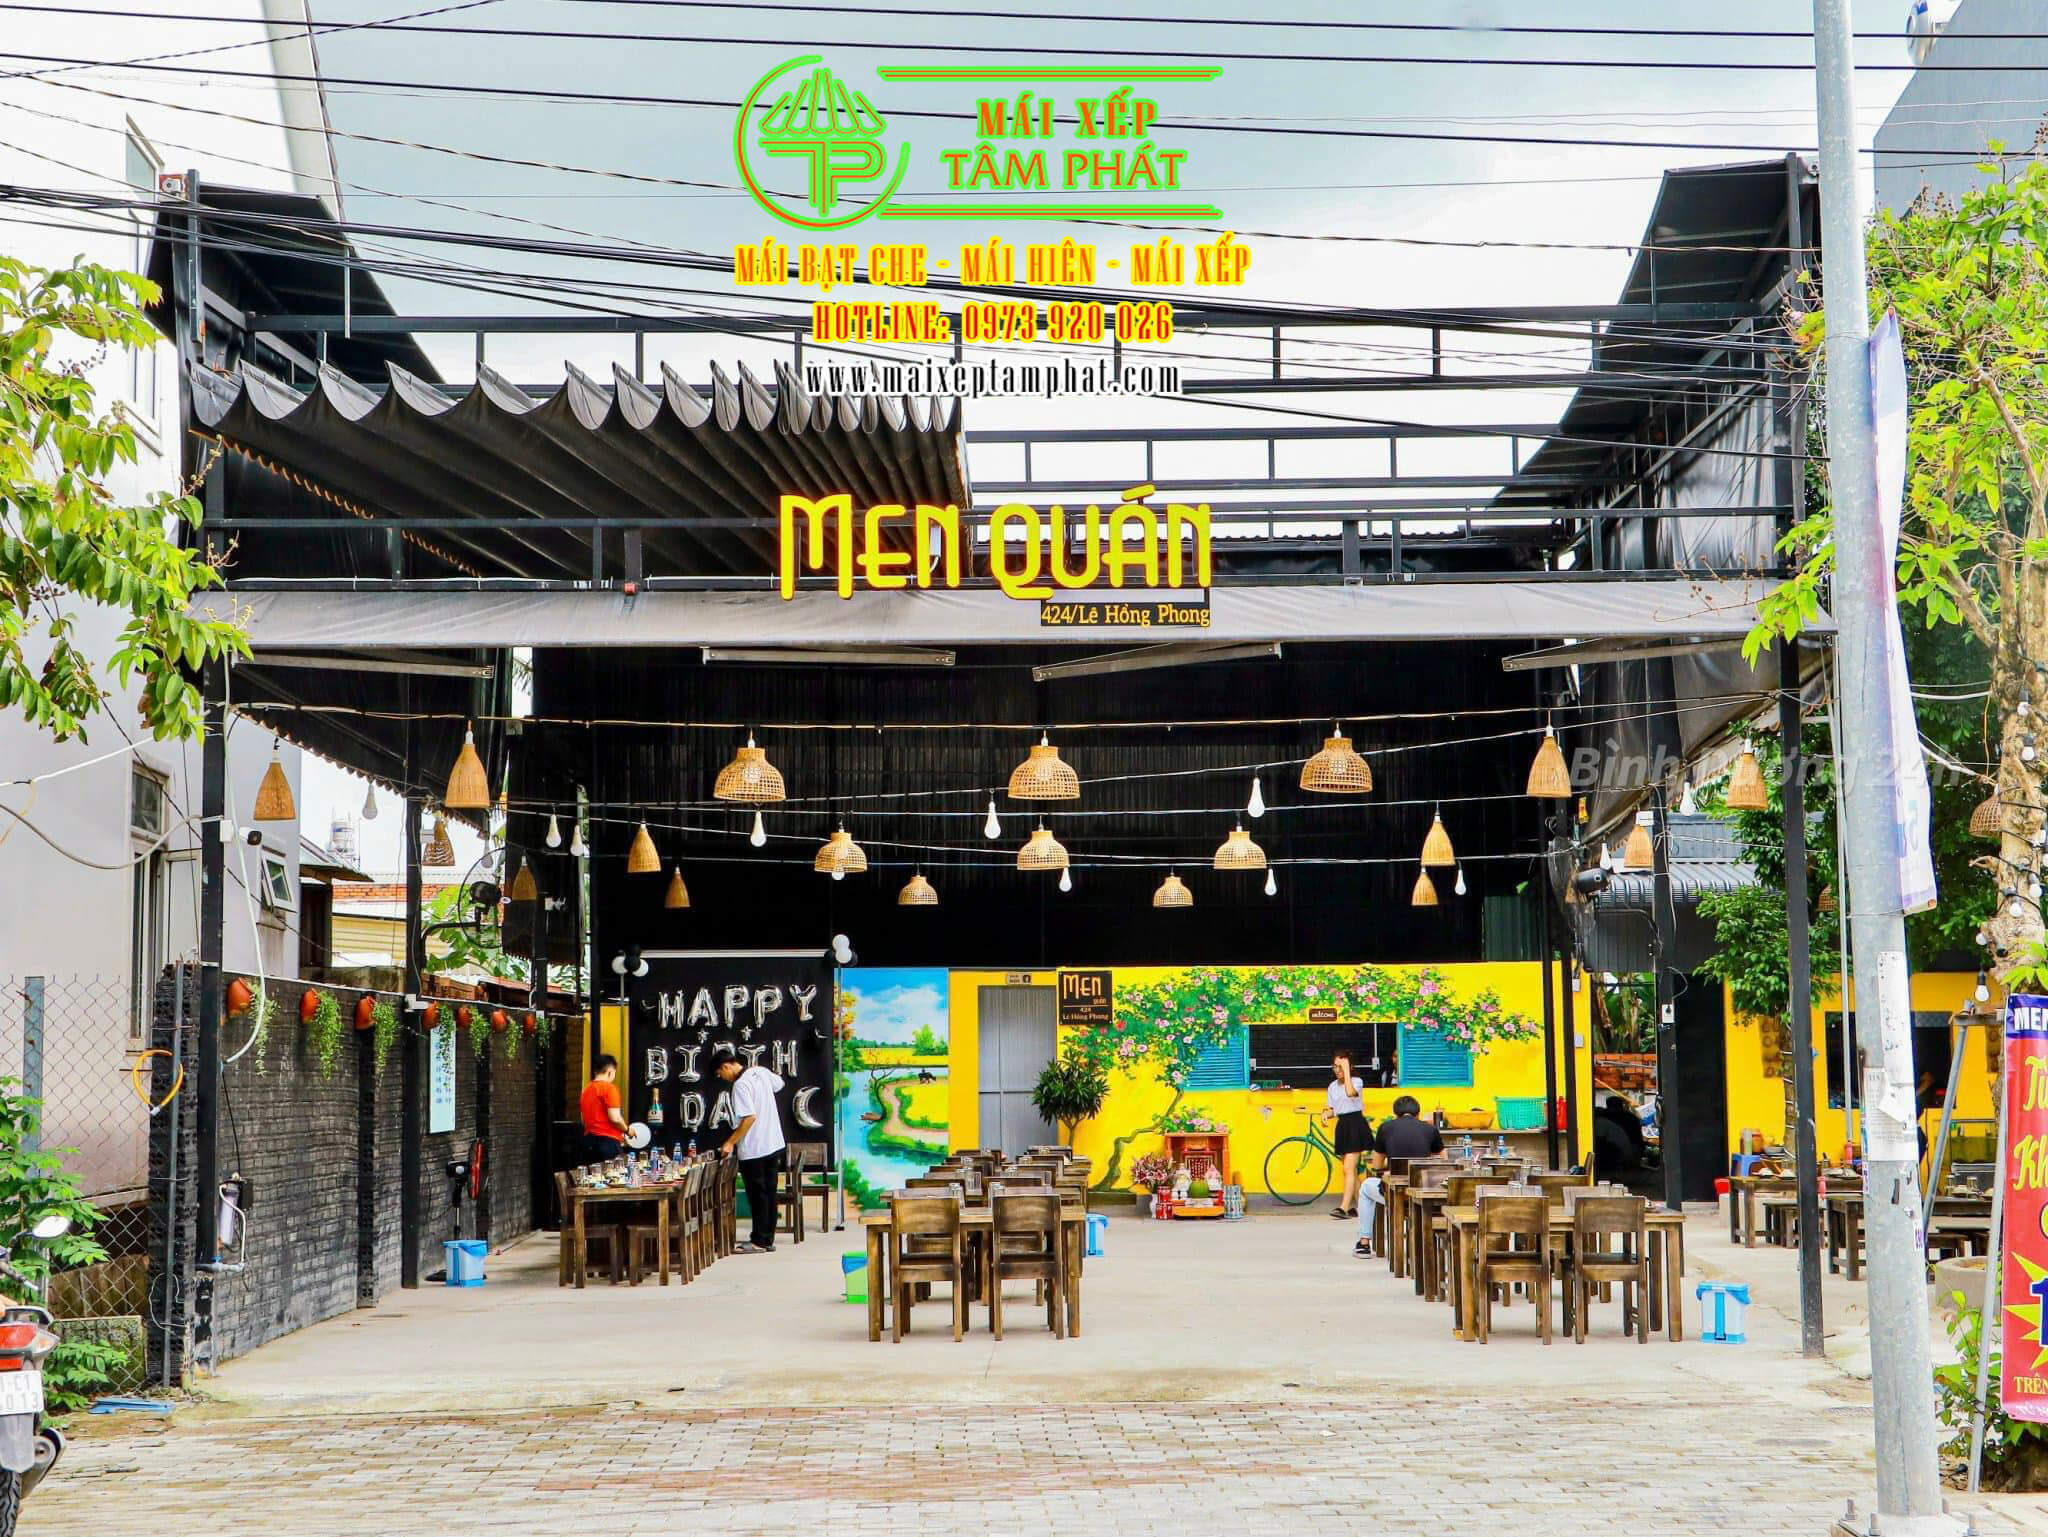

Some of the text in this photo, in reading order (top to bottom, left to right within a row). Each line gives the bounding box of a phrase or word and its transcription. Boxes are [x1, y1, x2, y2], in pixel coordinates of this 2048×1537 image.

[780, 484, 1212, 600] MEN QUÁN
[1041, 603, 1210, 627] 424/Lê Hồng Phong
[1063, 974, 1102, 999] MEN
[658, 984, 817, 1030] HAPPY
